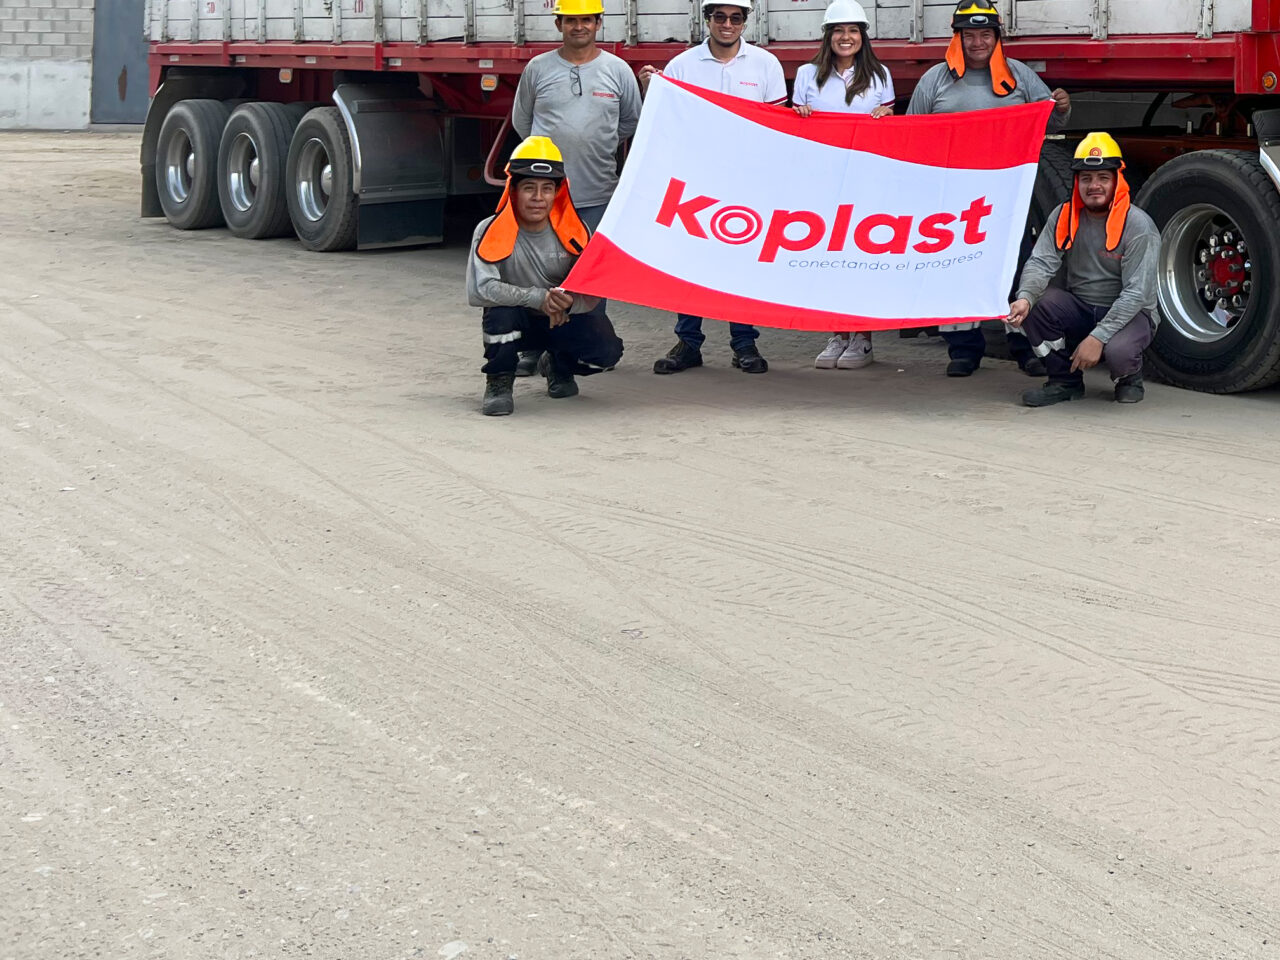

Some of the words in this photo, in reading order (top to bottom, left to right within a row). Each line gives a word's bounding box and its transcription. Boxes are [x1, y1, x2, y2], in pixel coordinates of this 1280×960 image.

[655, 177, 993, 263] koplast
[788, 258, 890, 271] conectando
[896, 259, 910, 271] el
[915, 250, 984, 272] progreso
